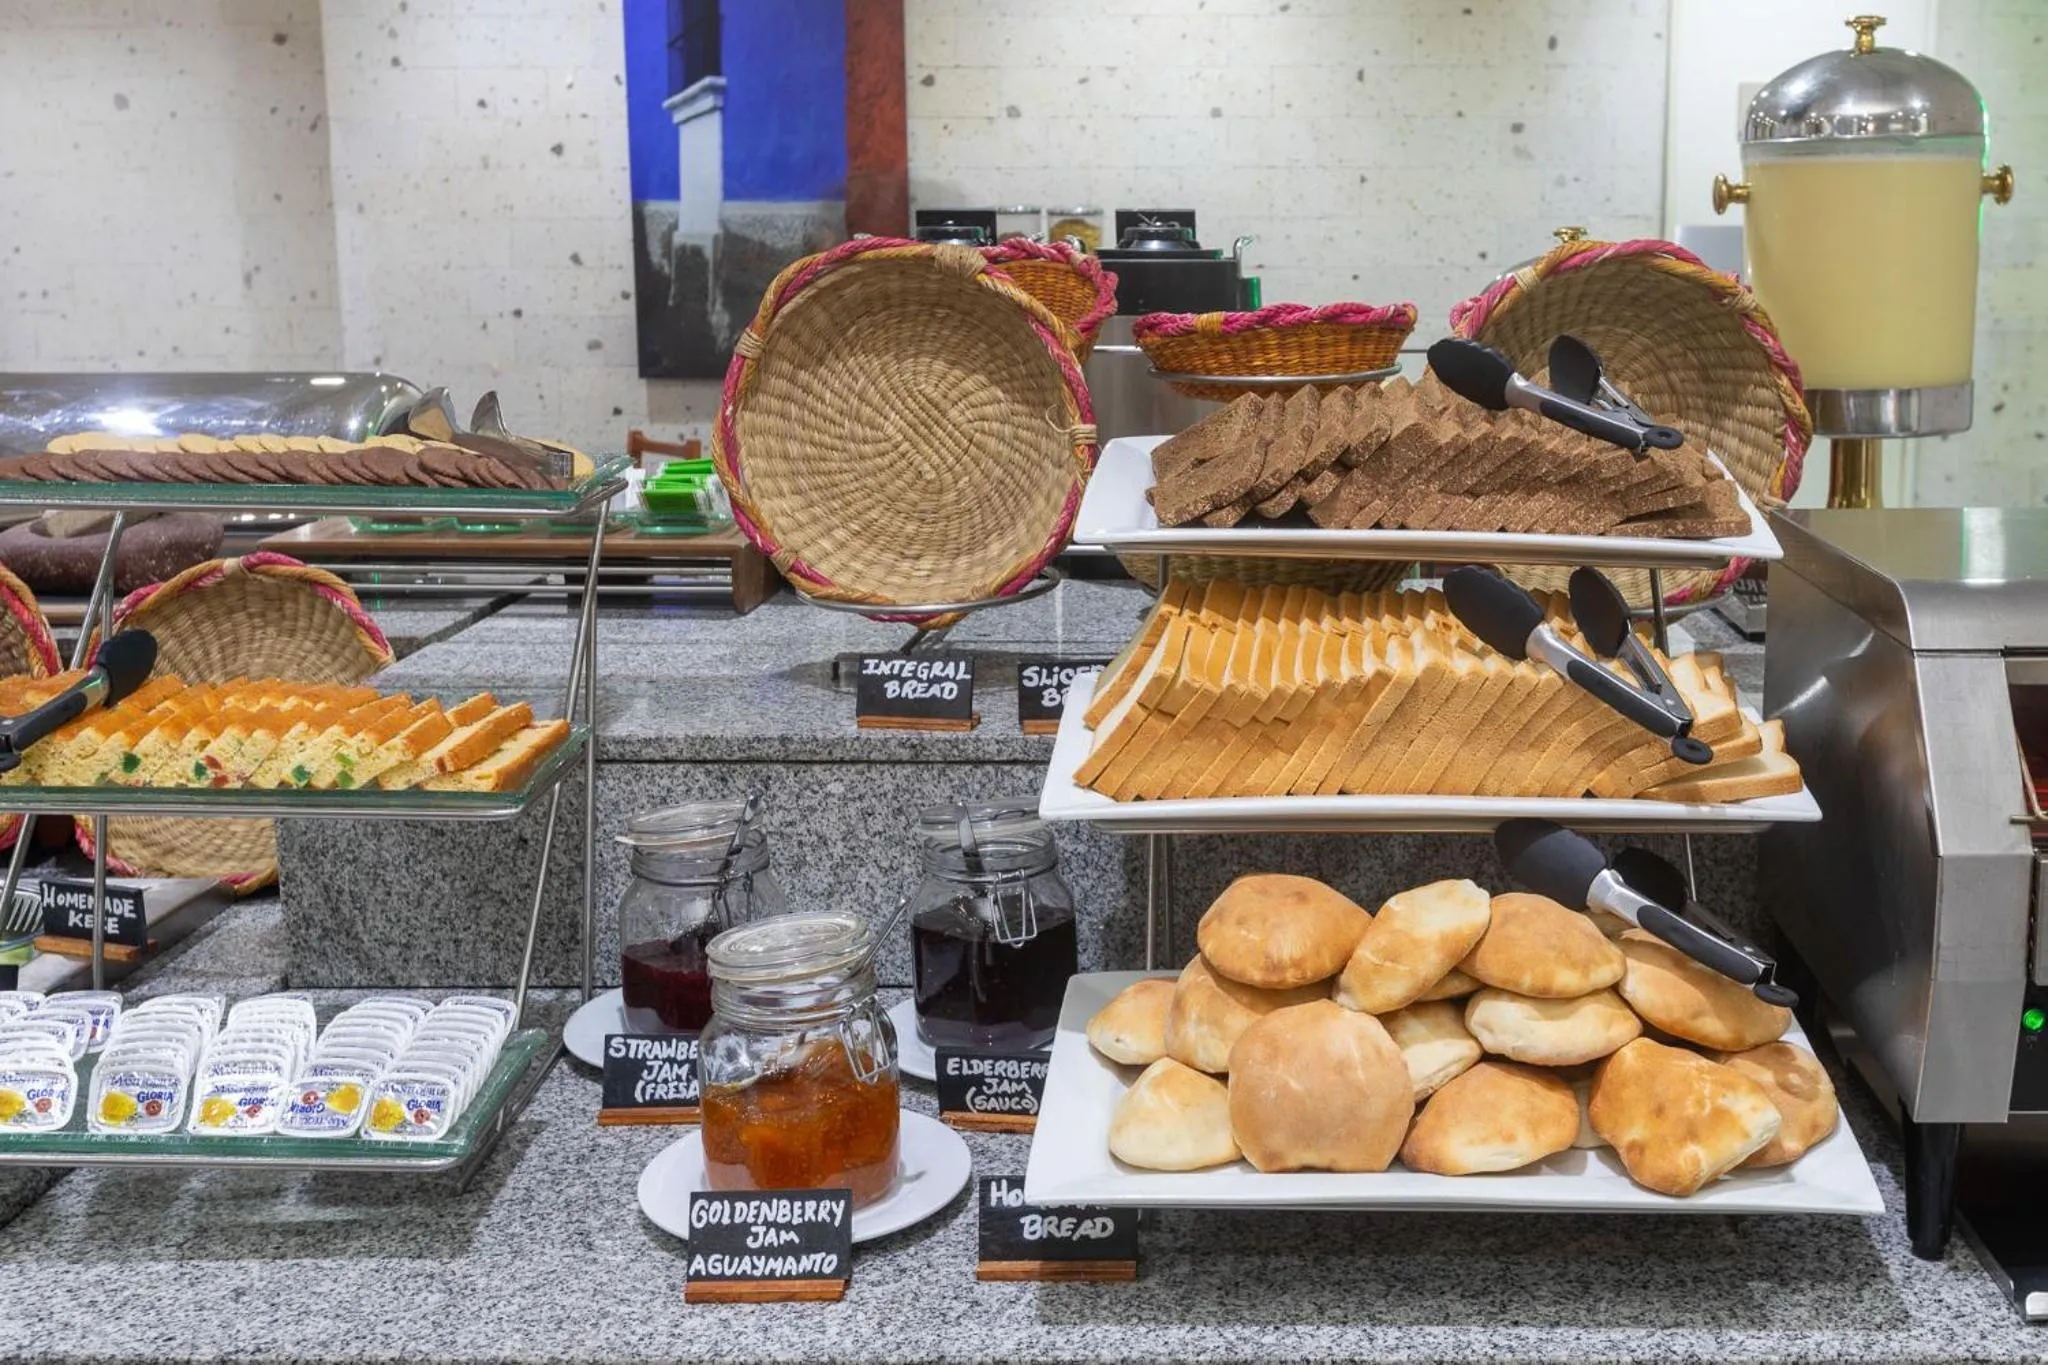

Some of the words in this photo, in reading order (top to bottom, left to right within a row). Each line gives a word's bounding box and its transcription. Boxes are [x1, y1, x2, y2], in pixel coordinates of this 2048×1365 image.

[862, 658, 972, 680] INTEGRAL
[884, 680, 958, 700] BREAD
[67, 909, 120, 934] KEE
[608, 1036, 699, 1060] STRAWBE
[641, 1060, 689, 1082] JAM
[27, 1088, 67, 1102] GLORA
[137, 1090, 175, 1104] GLORIA
[634, 1079, 700, 1103] (FRESA
[982, 1078, 1032, 1095] JAM
[238, 1096, 279, 1107] GLOR
[406, 1098, 442, 1113] GLORIA
[965, 1086, 1039, 1115] (SAUCO)
[690, 1198, 846, 1229] GOLDENBERRY
[746, 1225, 801, 1248] JAM
[1019, 1214, 1116, 1241] BREAD
[688, 1252, 838, 1278] AGUAYMANTO
